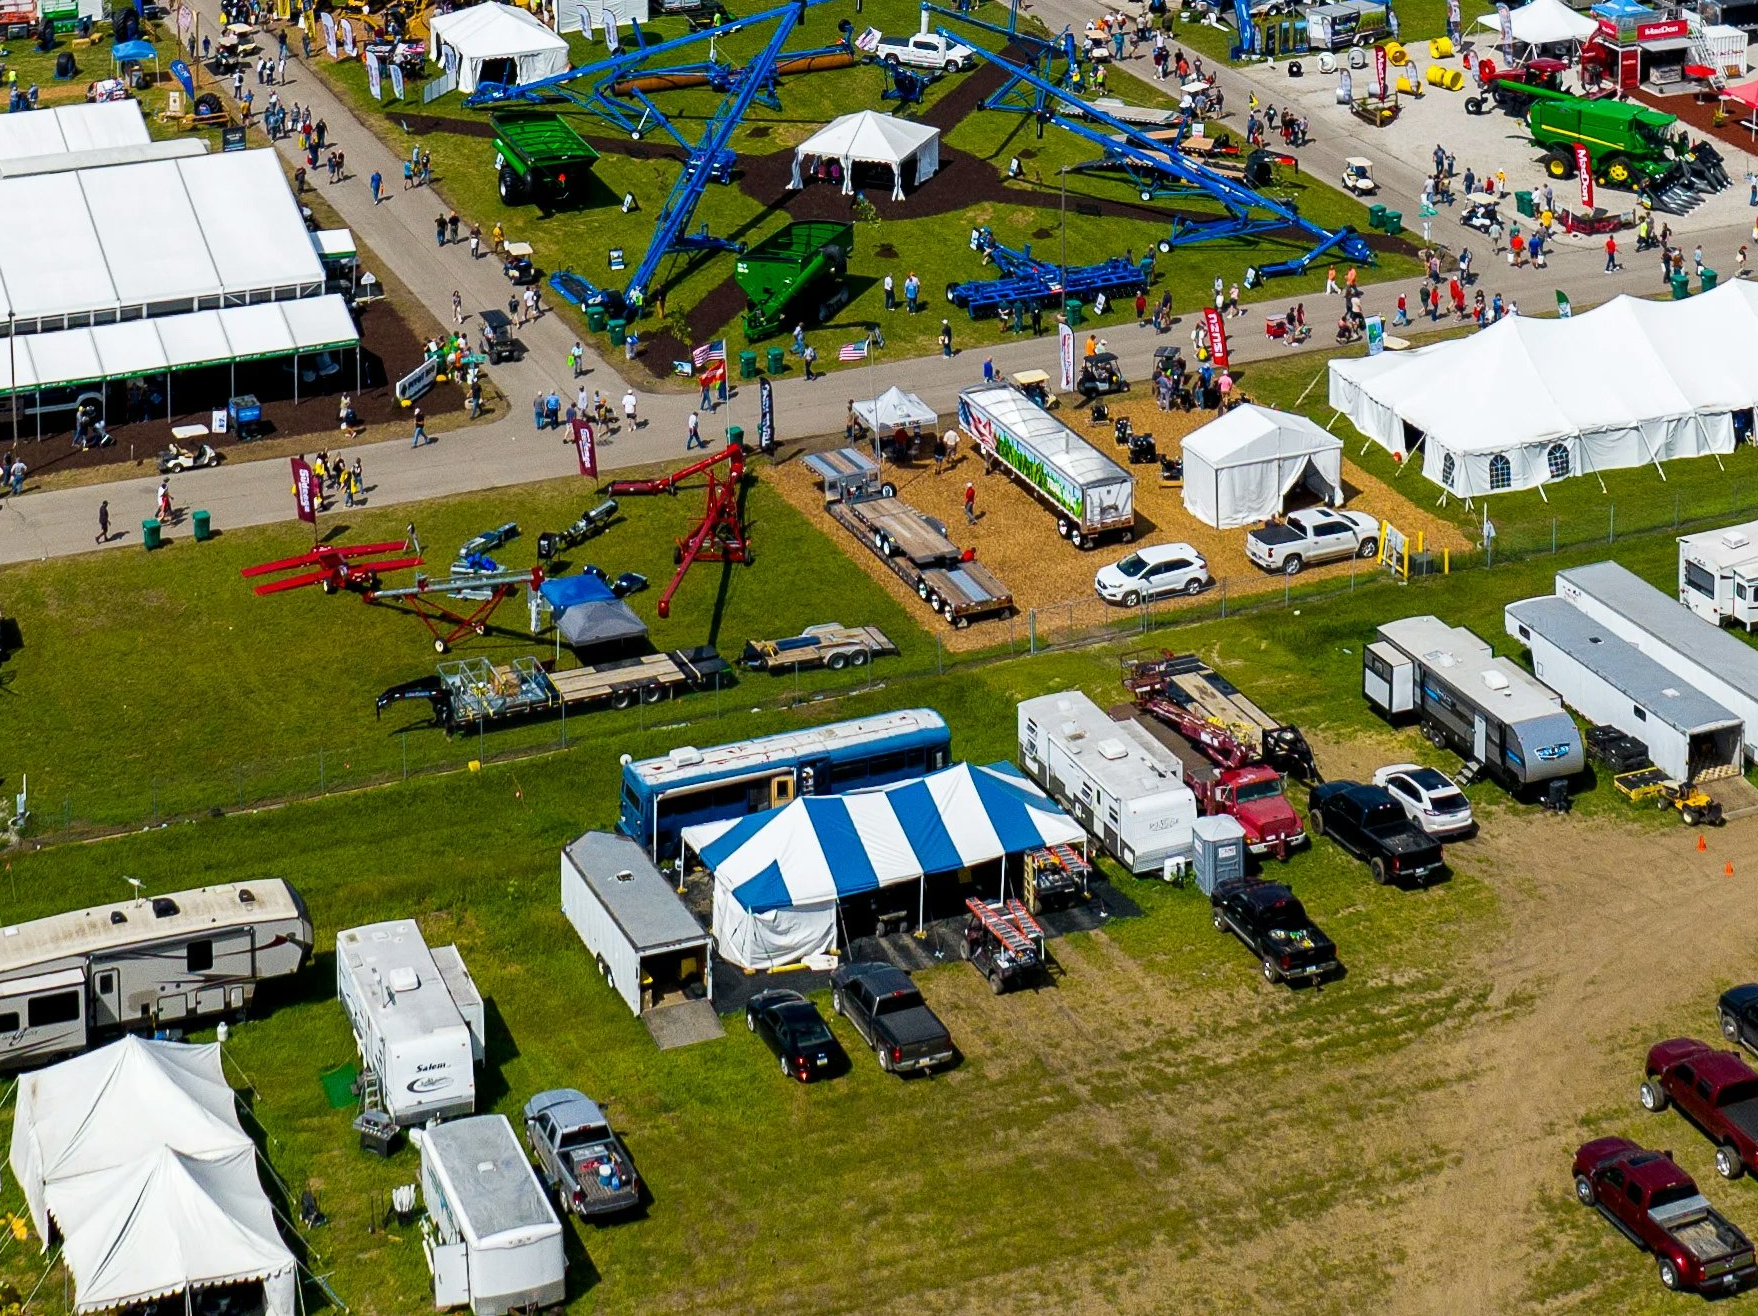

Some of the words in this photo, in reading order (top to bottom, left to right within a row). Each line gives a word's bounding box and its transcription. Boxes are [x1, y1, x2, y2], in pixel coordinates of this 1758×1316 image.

[1644, 25, 1679, 36] MacDon
[1577, 149, 1589, 201] MacDon
[1208, 312, 1223, 358] ISUZU
[416, 1061, 447, 1074] Salem
